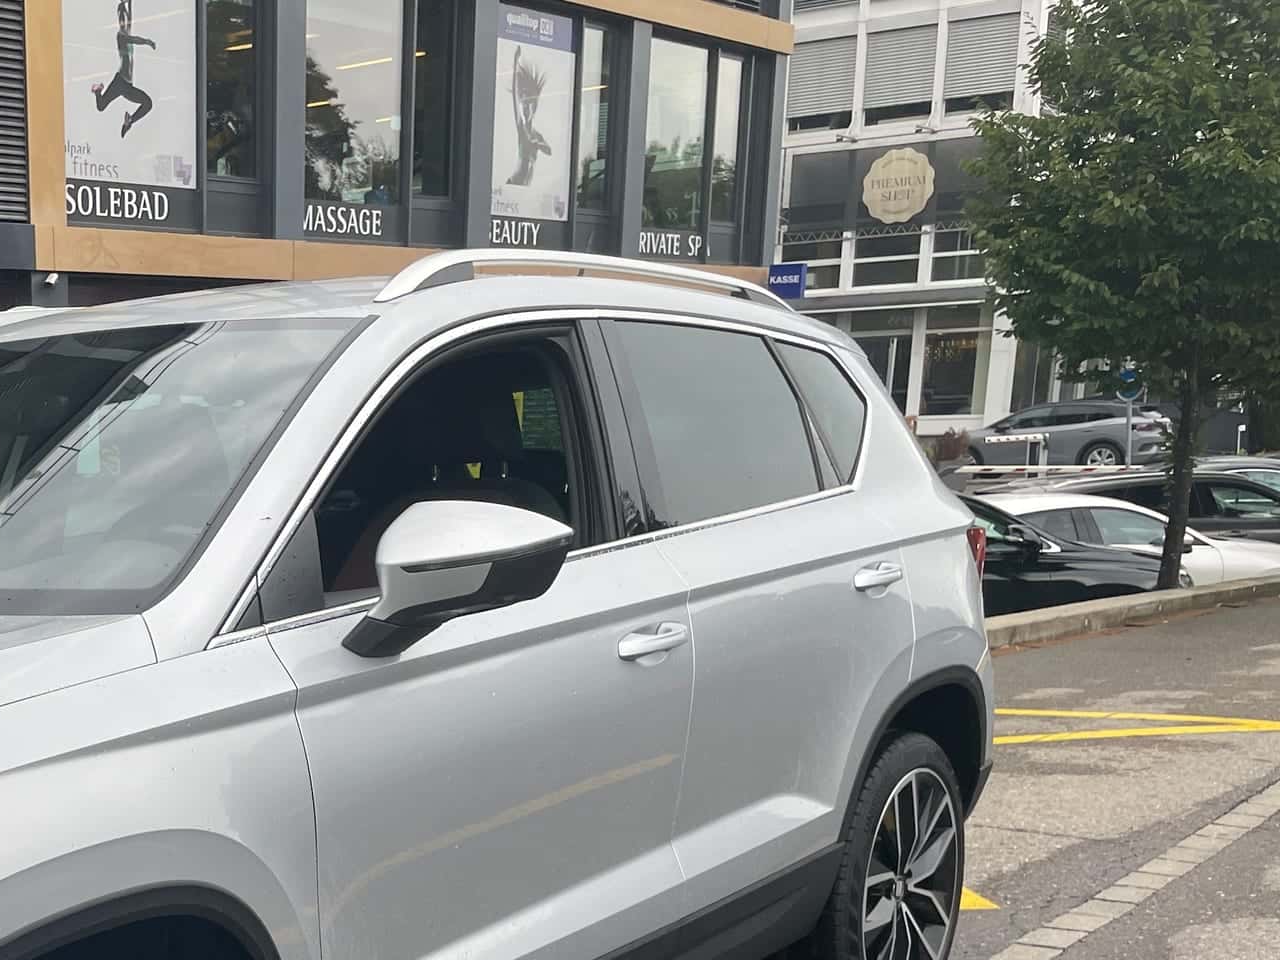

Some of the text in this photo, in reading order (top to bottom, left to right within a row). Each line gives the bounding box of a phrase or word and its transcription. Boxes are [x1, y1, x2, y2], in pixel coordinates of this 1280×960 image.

[72, 156, 120, 178] fitness
[65, 183, 169, 221] SOLEBAD
[488, 219, 541, 246] EAUTY
[769, 274, 800, 285] KASSE
